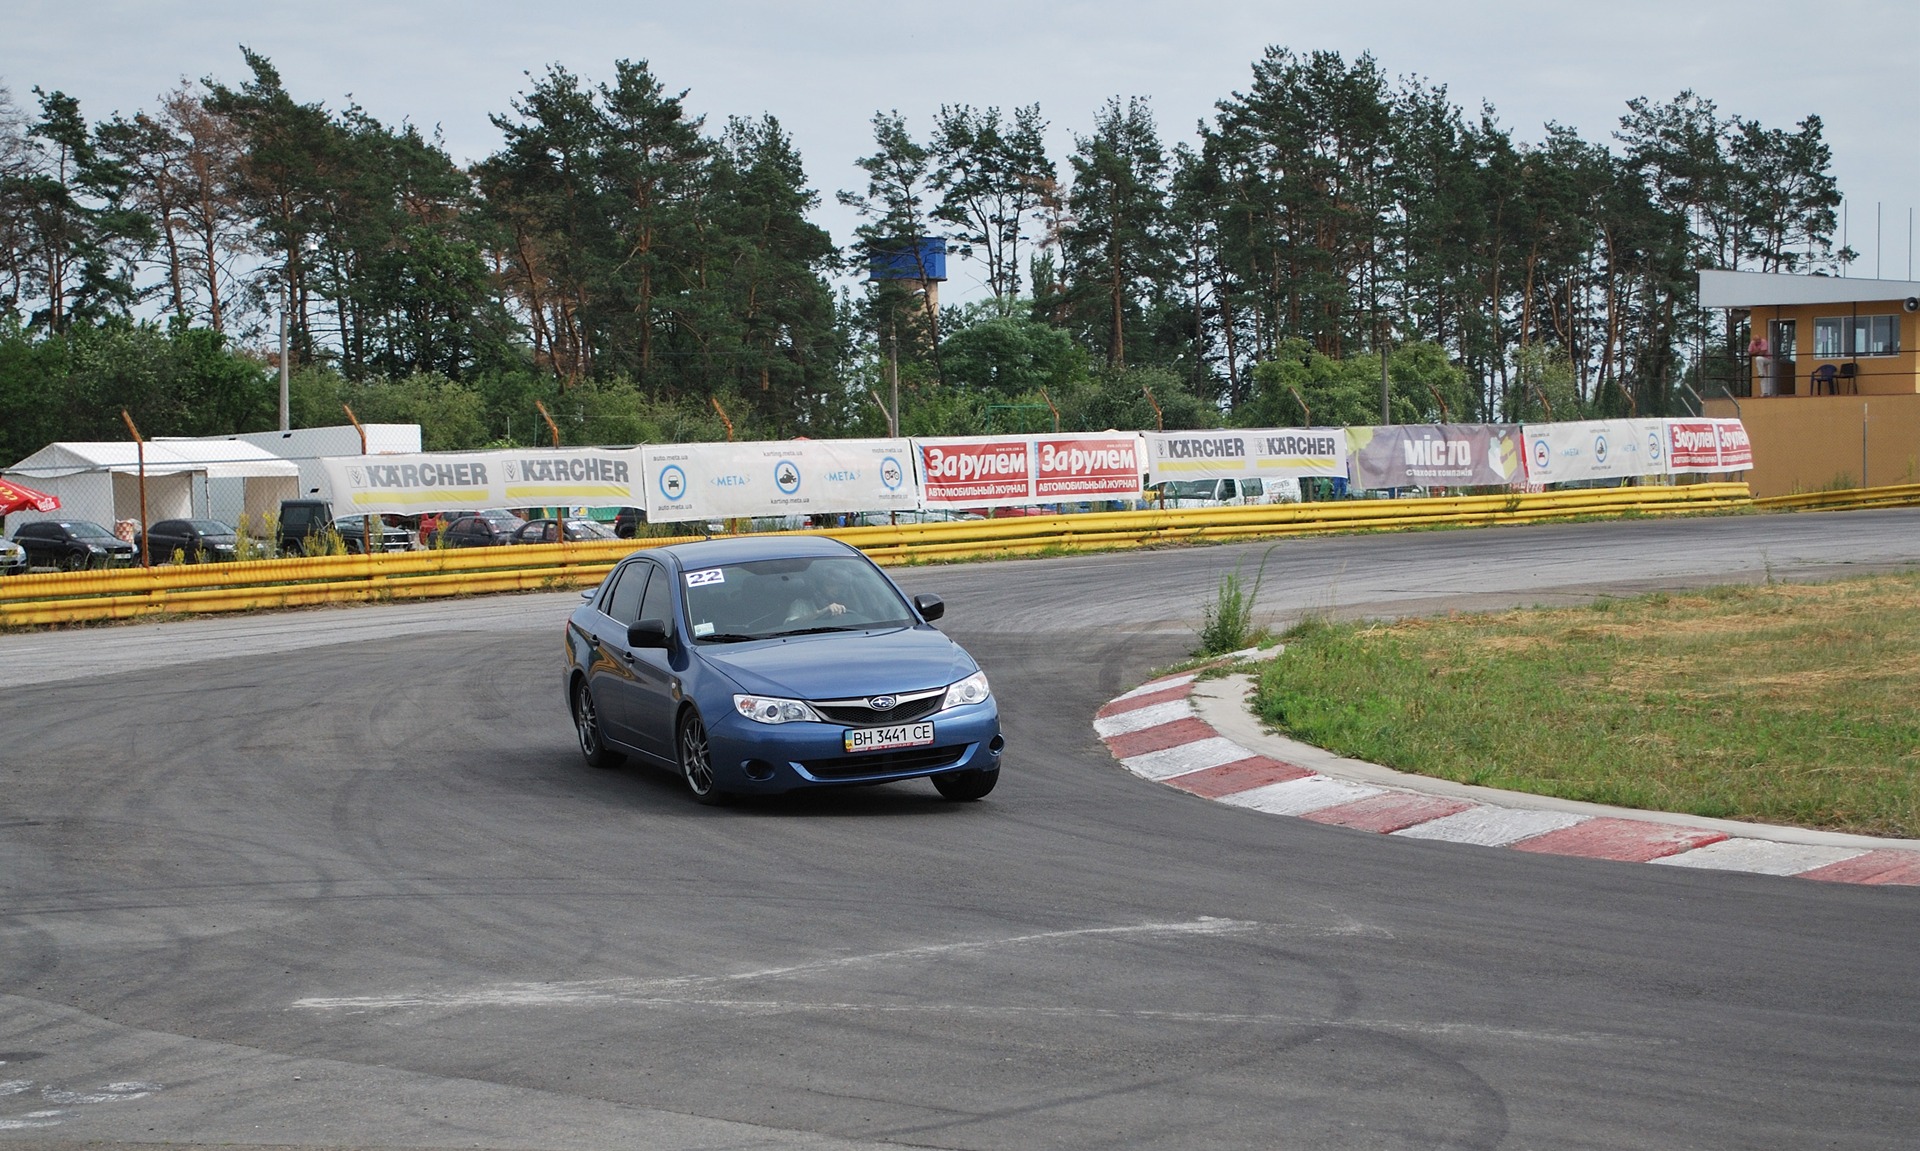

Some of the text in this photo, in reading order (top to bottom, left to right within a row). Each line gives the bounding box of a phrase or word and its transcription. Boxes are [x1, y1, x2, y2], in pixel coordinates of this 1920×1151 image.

[1167, 438, 1245, 458] KÄRCHER
[1266, 436, 1335, 456] KÄRCHER
[365, 463, 488, 487] KÄRCHER
[520, 458, 629, 482] KÄRCHER
[928, 484, 1027, 497] АВТОМОБИЛЬНЫЙ ЖУРНАЛ
[1038, 479, 1137, 492] АВТОМОБИЛЬНЫЙ ЖУРНАЛ
[689, 571, 722, 584] 22
[854, 725, 931, 746] BH 3441 CE
